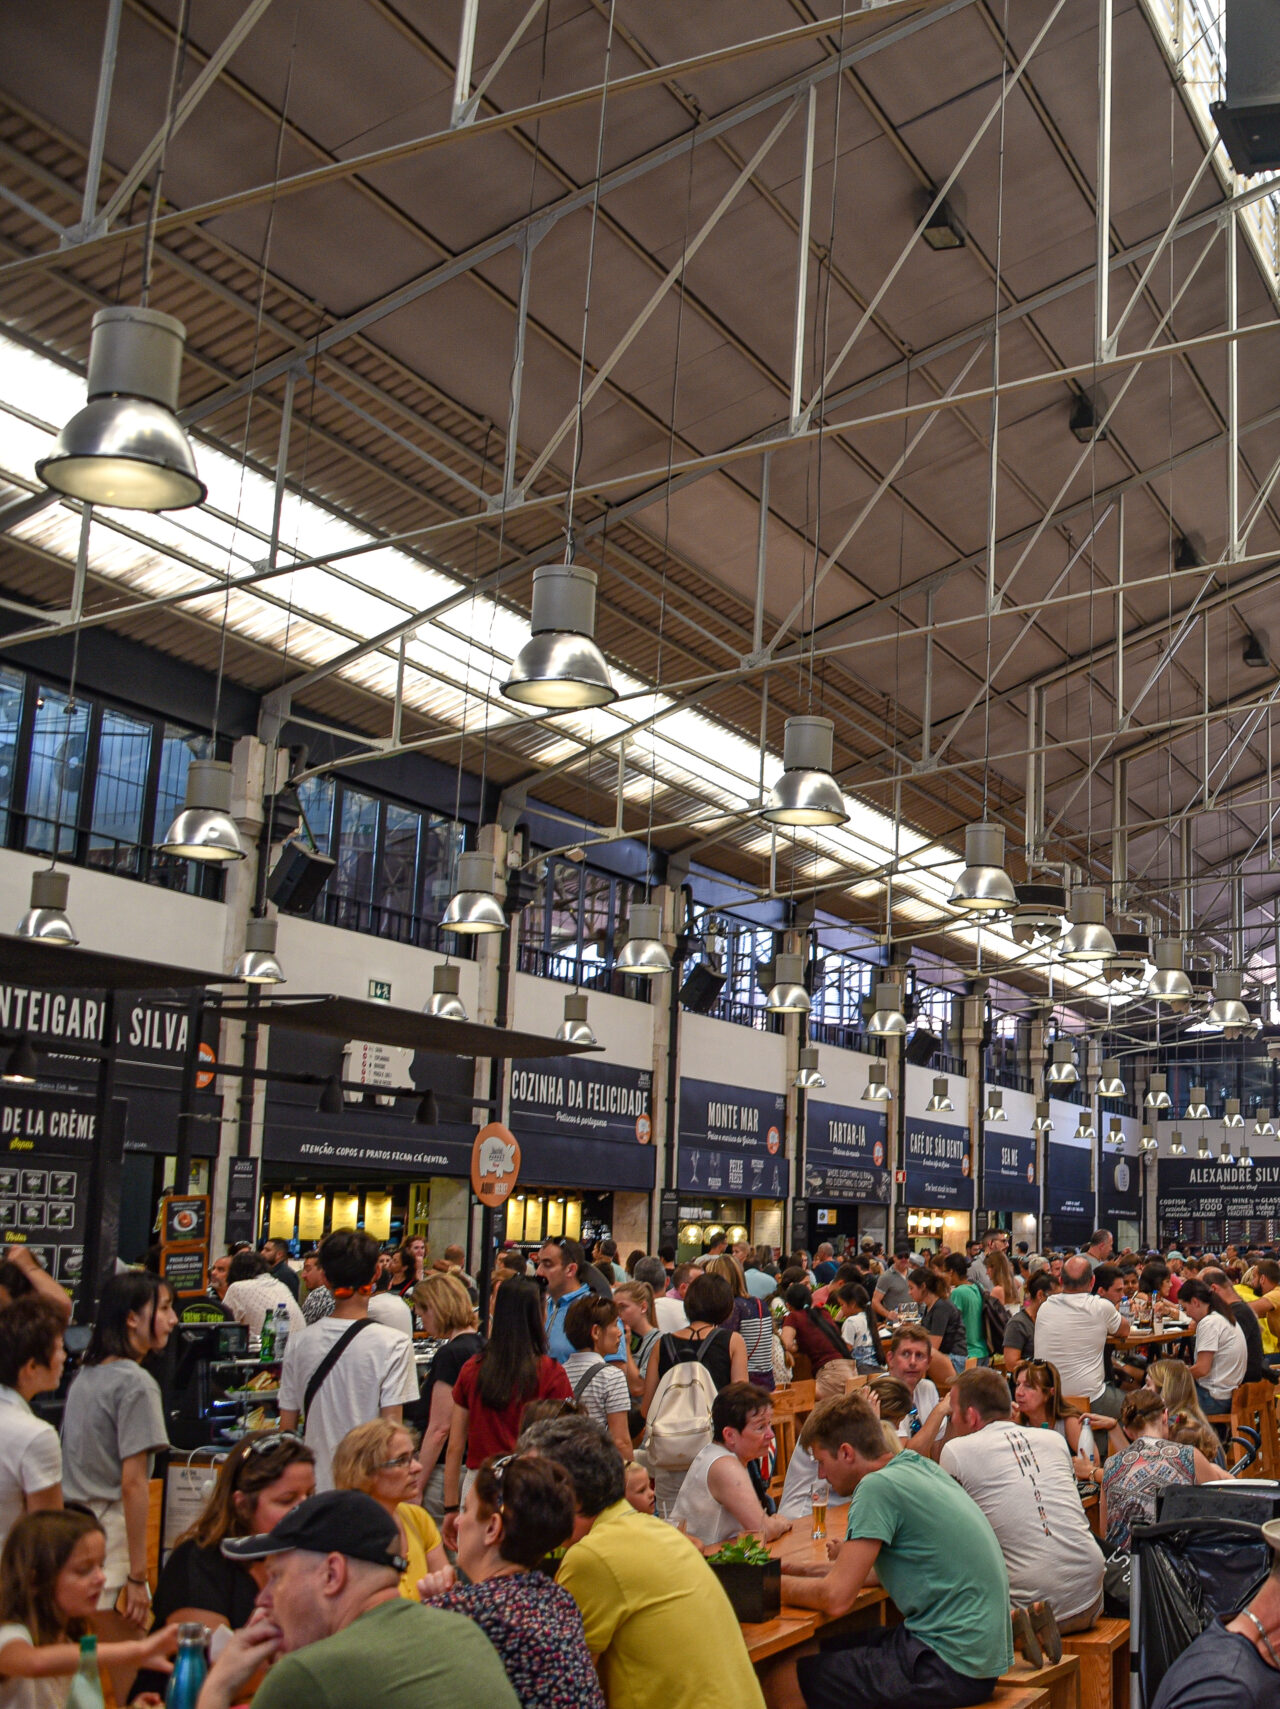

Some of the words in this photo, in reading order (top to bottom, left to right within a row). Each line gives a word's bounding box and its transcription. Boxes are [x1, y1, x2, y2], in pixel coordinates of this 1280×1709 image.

[129, 1006, 189, 1052] SILVA
[511, 1070, 564, 1106] COZINHA
[568, 1079, 583, 1109] DA
[587, 1082, 648, 1117] FELICIDADE
[2, 1106, 22, 1133] DE
[26, 1109, 44, 1136] LA
[50, 1108, 96, 1140] CRÈME
[707, 1101, 738, 1130] MONTE
[740, 1106, 759, 1133] MAR
[828, 1120, 866, 1147] TARTAR-IA
[910, 1131, 924, 1155] CAFÉ
[925, 1136, 933, 1155] DE
[935, 1134, 945, 1157] SÃO
[947, 1139, 964, 1160] BENTO
[300, 1142, 335, 1155] ATENÇÃO:
[336, 1147, 358, 1157] COPOS
[359, 1149, 364, 1157] E
[366, 1149, 390, 1160] PRATOS
[392, 1151, 412, 1161] FICAM
[1189, 1168, 1252, 1183] ALEXANDRE
